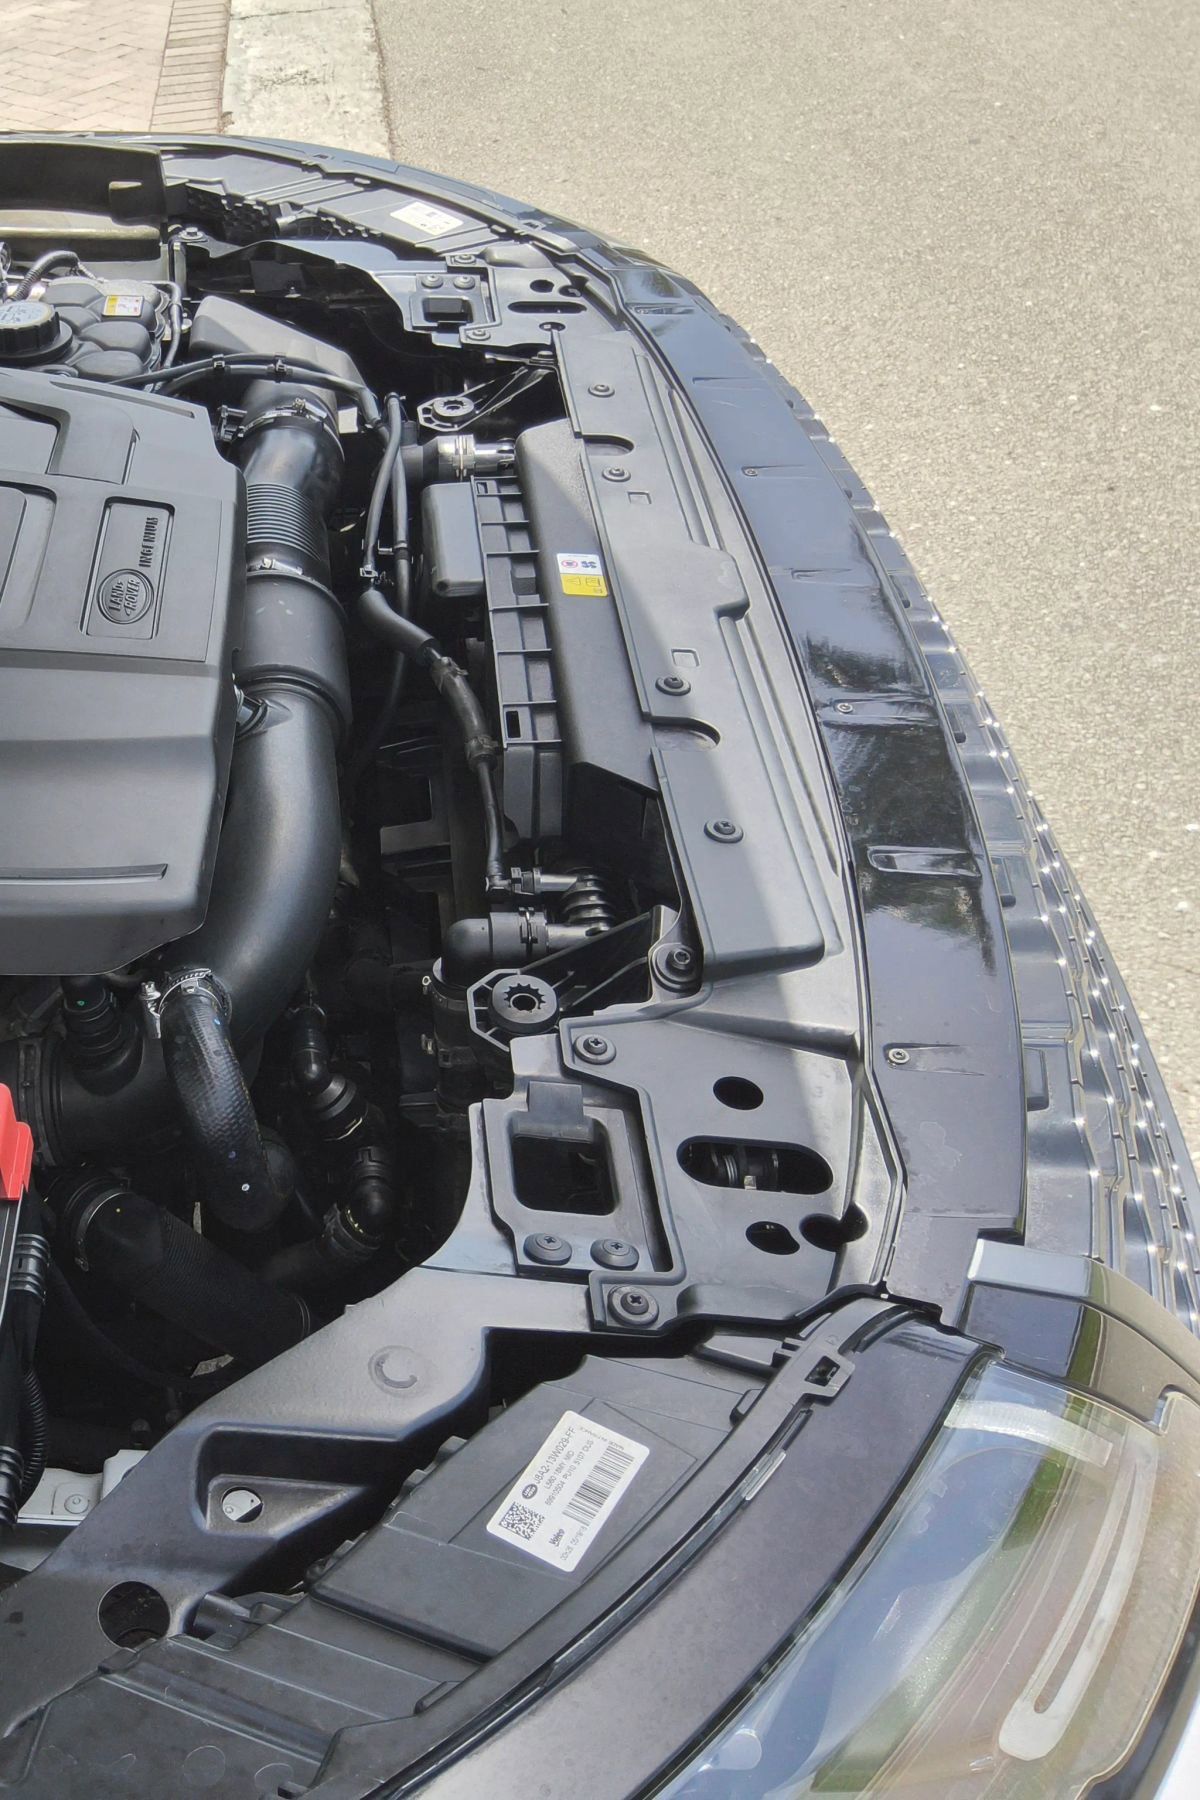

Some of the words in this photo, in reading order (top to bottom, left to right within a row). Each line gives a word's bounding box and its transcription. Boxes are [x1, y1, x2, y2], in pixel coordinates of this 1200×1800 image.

[138, 516, 159, 568] INGENIUM
[109, 582, 124, 612] LAND
[124, 579, 140, 612] ROVER
